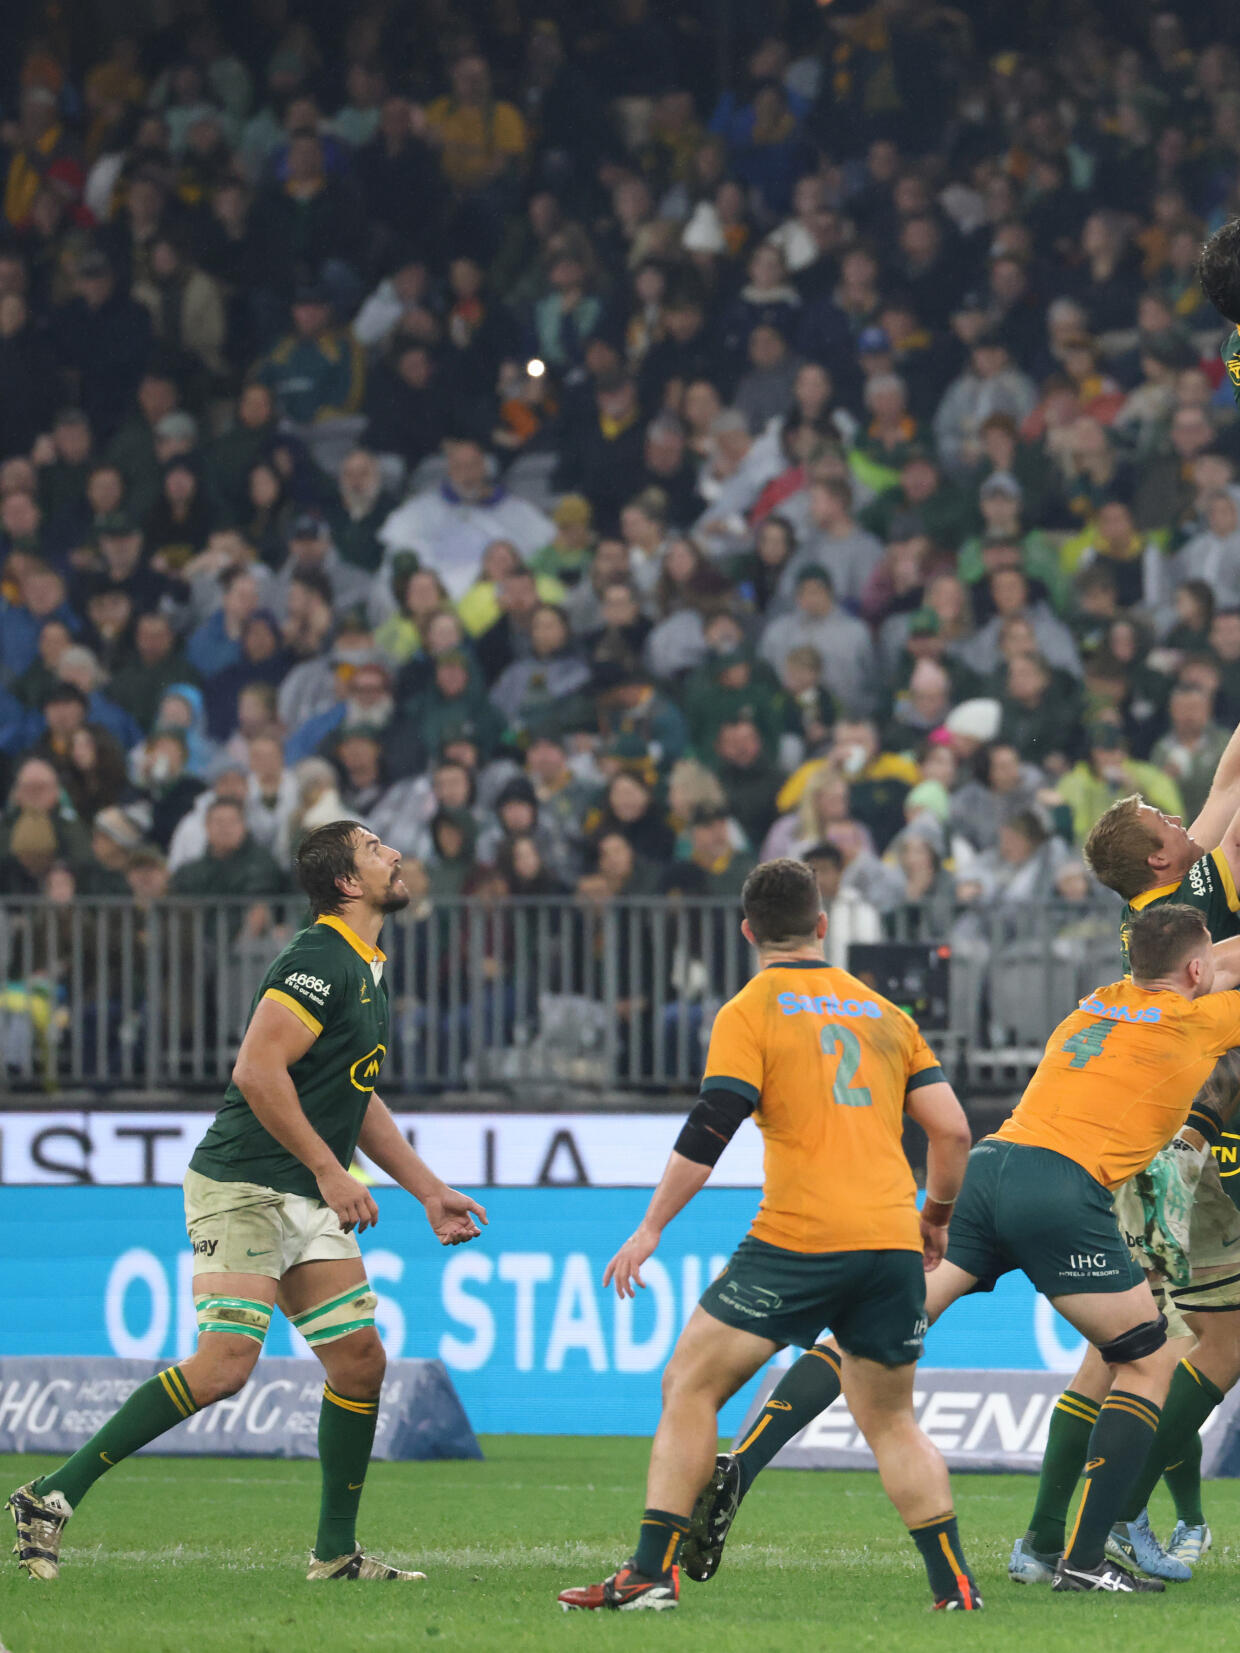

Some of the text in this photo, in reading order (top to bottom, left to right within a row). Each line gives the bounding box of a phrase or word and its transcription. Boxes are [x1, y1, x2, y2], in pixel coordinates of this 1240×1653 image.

[288, 972, 331, 996] 46664
[777, 991, 883, 1019] Santos
[1061, 1019, 1119, 1069] 4
[820, 1023, 873, 1107] 2
[1070, 1253, 1106, 1269] IHG
[438, 1250, 836, 1373] STADI
[913, 1318, 929, 1336] IH
[0, 1378, 74, 1435] HG
